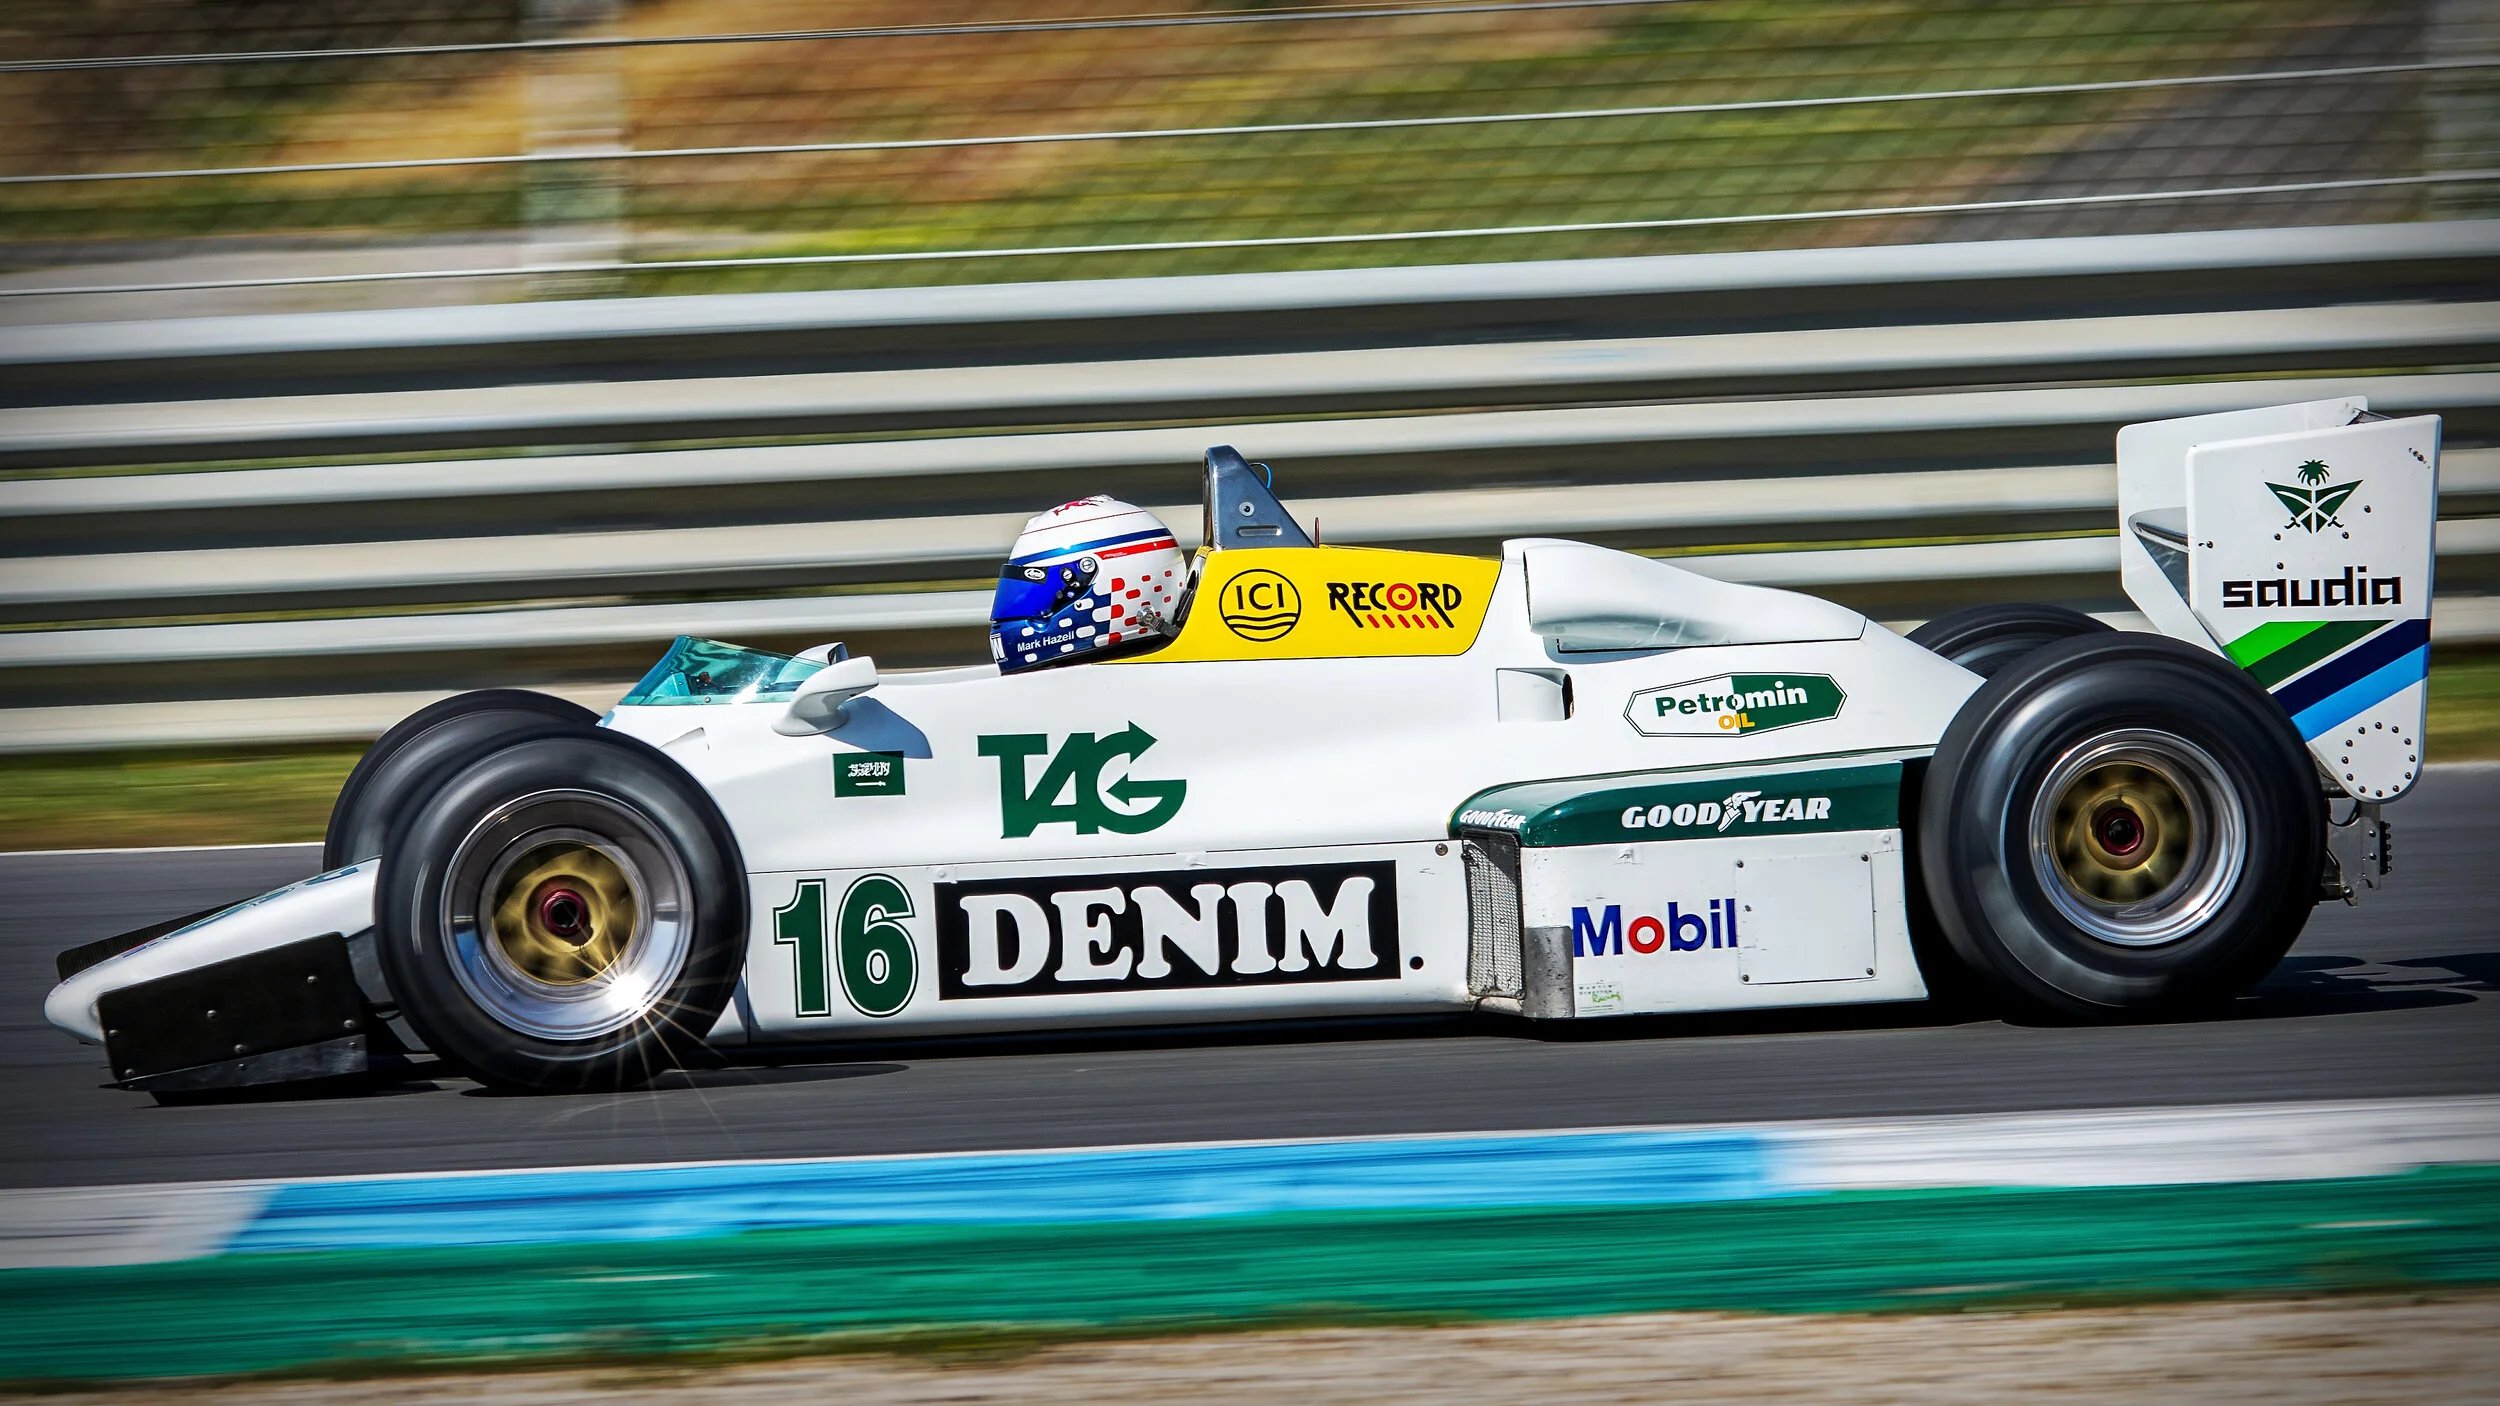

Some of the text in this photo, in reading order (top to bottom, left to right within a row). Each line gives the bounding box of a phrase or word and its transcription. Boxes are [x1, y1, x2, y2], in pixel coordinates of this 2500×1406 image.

[1236, 583, 1285, 609] ICI
[1326, 582, 1463, 629] RECORD
[2223, 565, 2402, 608] saudia
[1017, 639, 1041, 652] Mark
[1042, 630, 1075, 646] Hazell
[1655, 680, 1808, 717] Petromin
[1718, 712, 1755, 730] OIL
[977, 720, 1187, 838] TAG
[773, 872, 919, 1019] 16
[960, 876, 1379, 986] DENIM
[1571, 898, 1739, 957] Mobil
